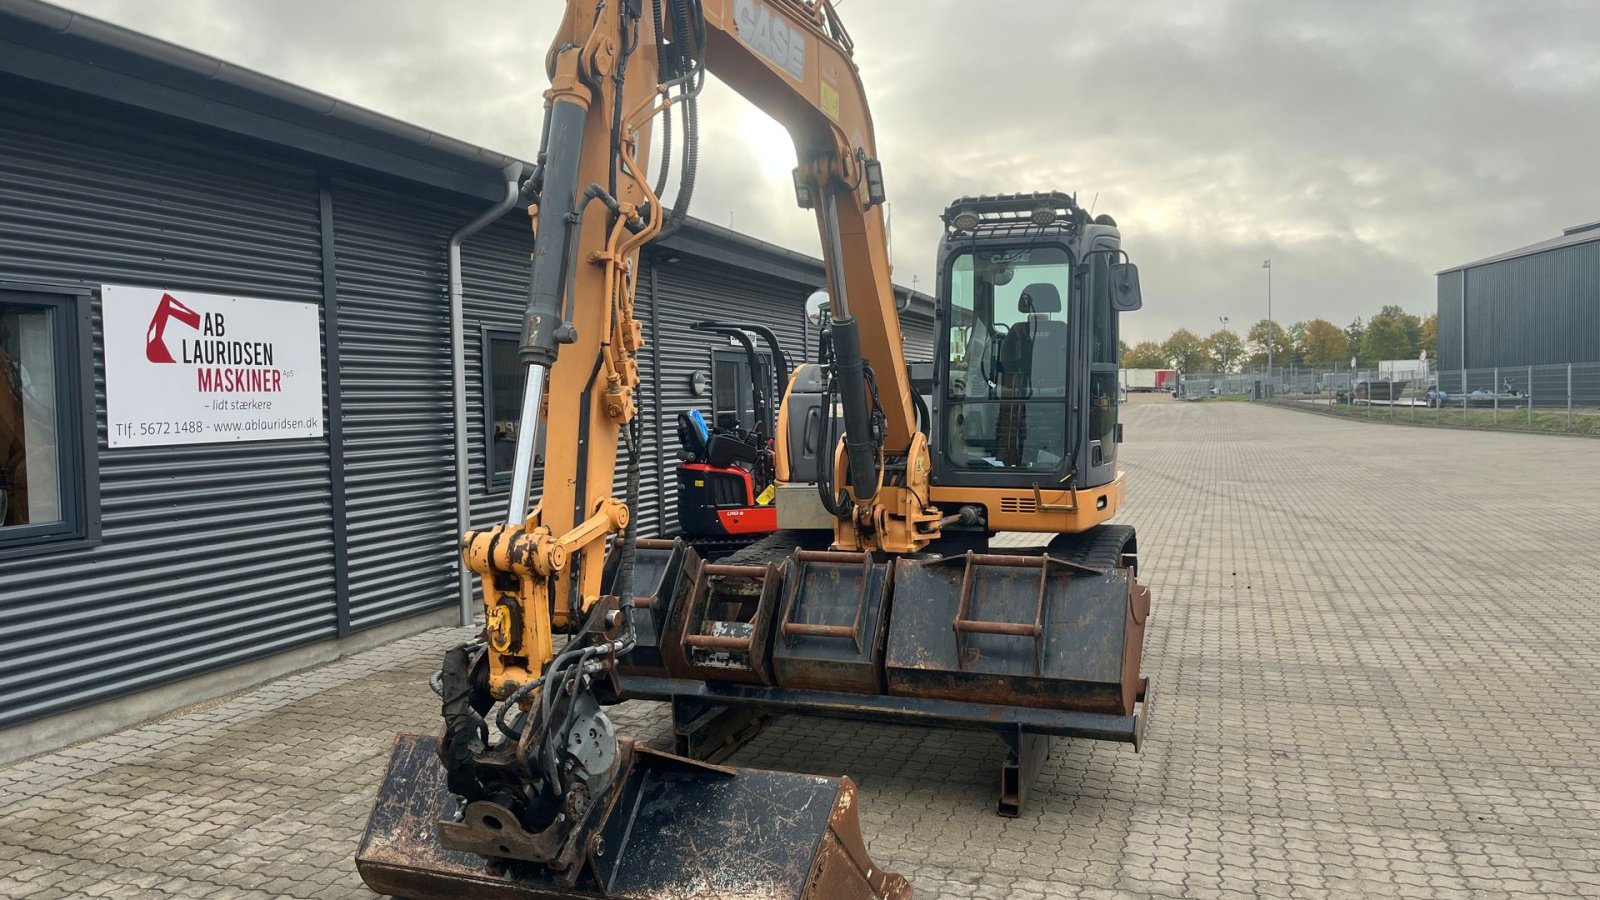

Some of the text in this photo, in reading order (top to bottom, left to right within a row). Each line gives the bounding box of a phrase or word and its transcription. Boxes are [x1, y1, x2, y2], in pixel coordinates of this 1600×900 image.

[734, 0, 806, 82] CASE
[203, 312, 225, 337] AB
[182, 339, 273, 366] LAURIDSEN
[197, 368, 294, 393] MASKINER ApS
[212, 399, 229, 411] lidt
[230, 400, 272, 411] stærkere
[115, 423, 136, 439] Tlf.
[140, 422, 171, 436] 5672
[174, 421, 203, 434] 1488
[214, 416, 318, 432] www.ablauridsen.dk
